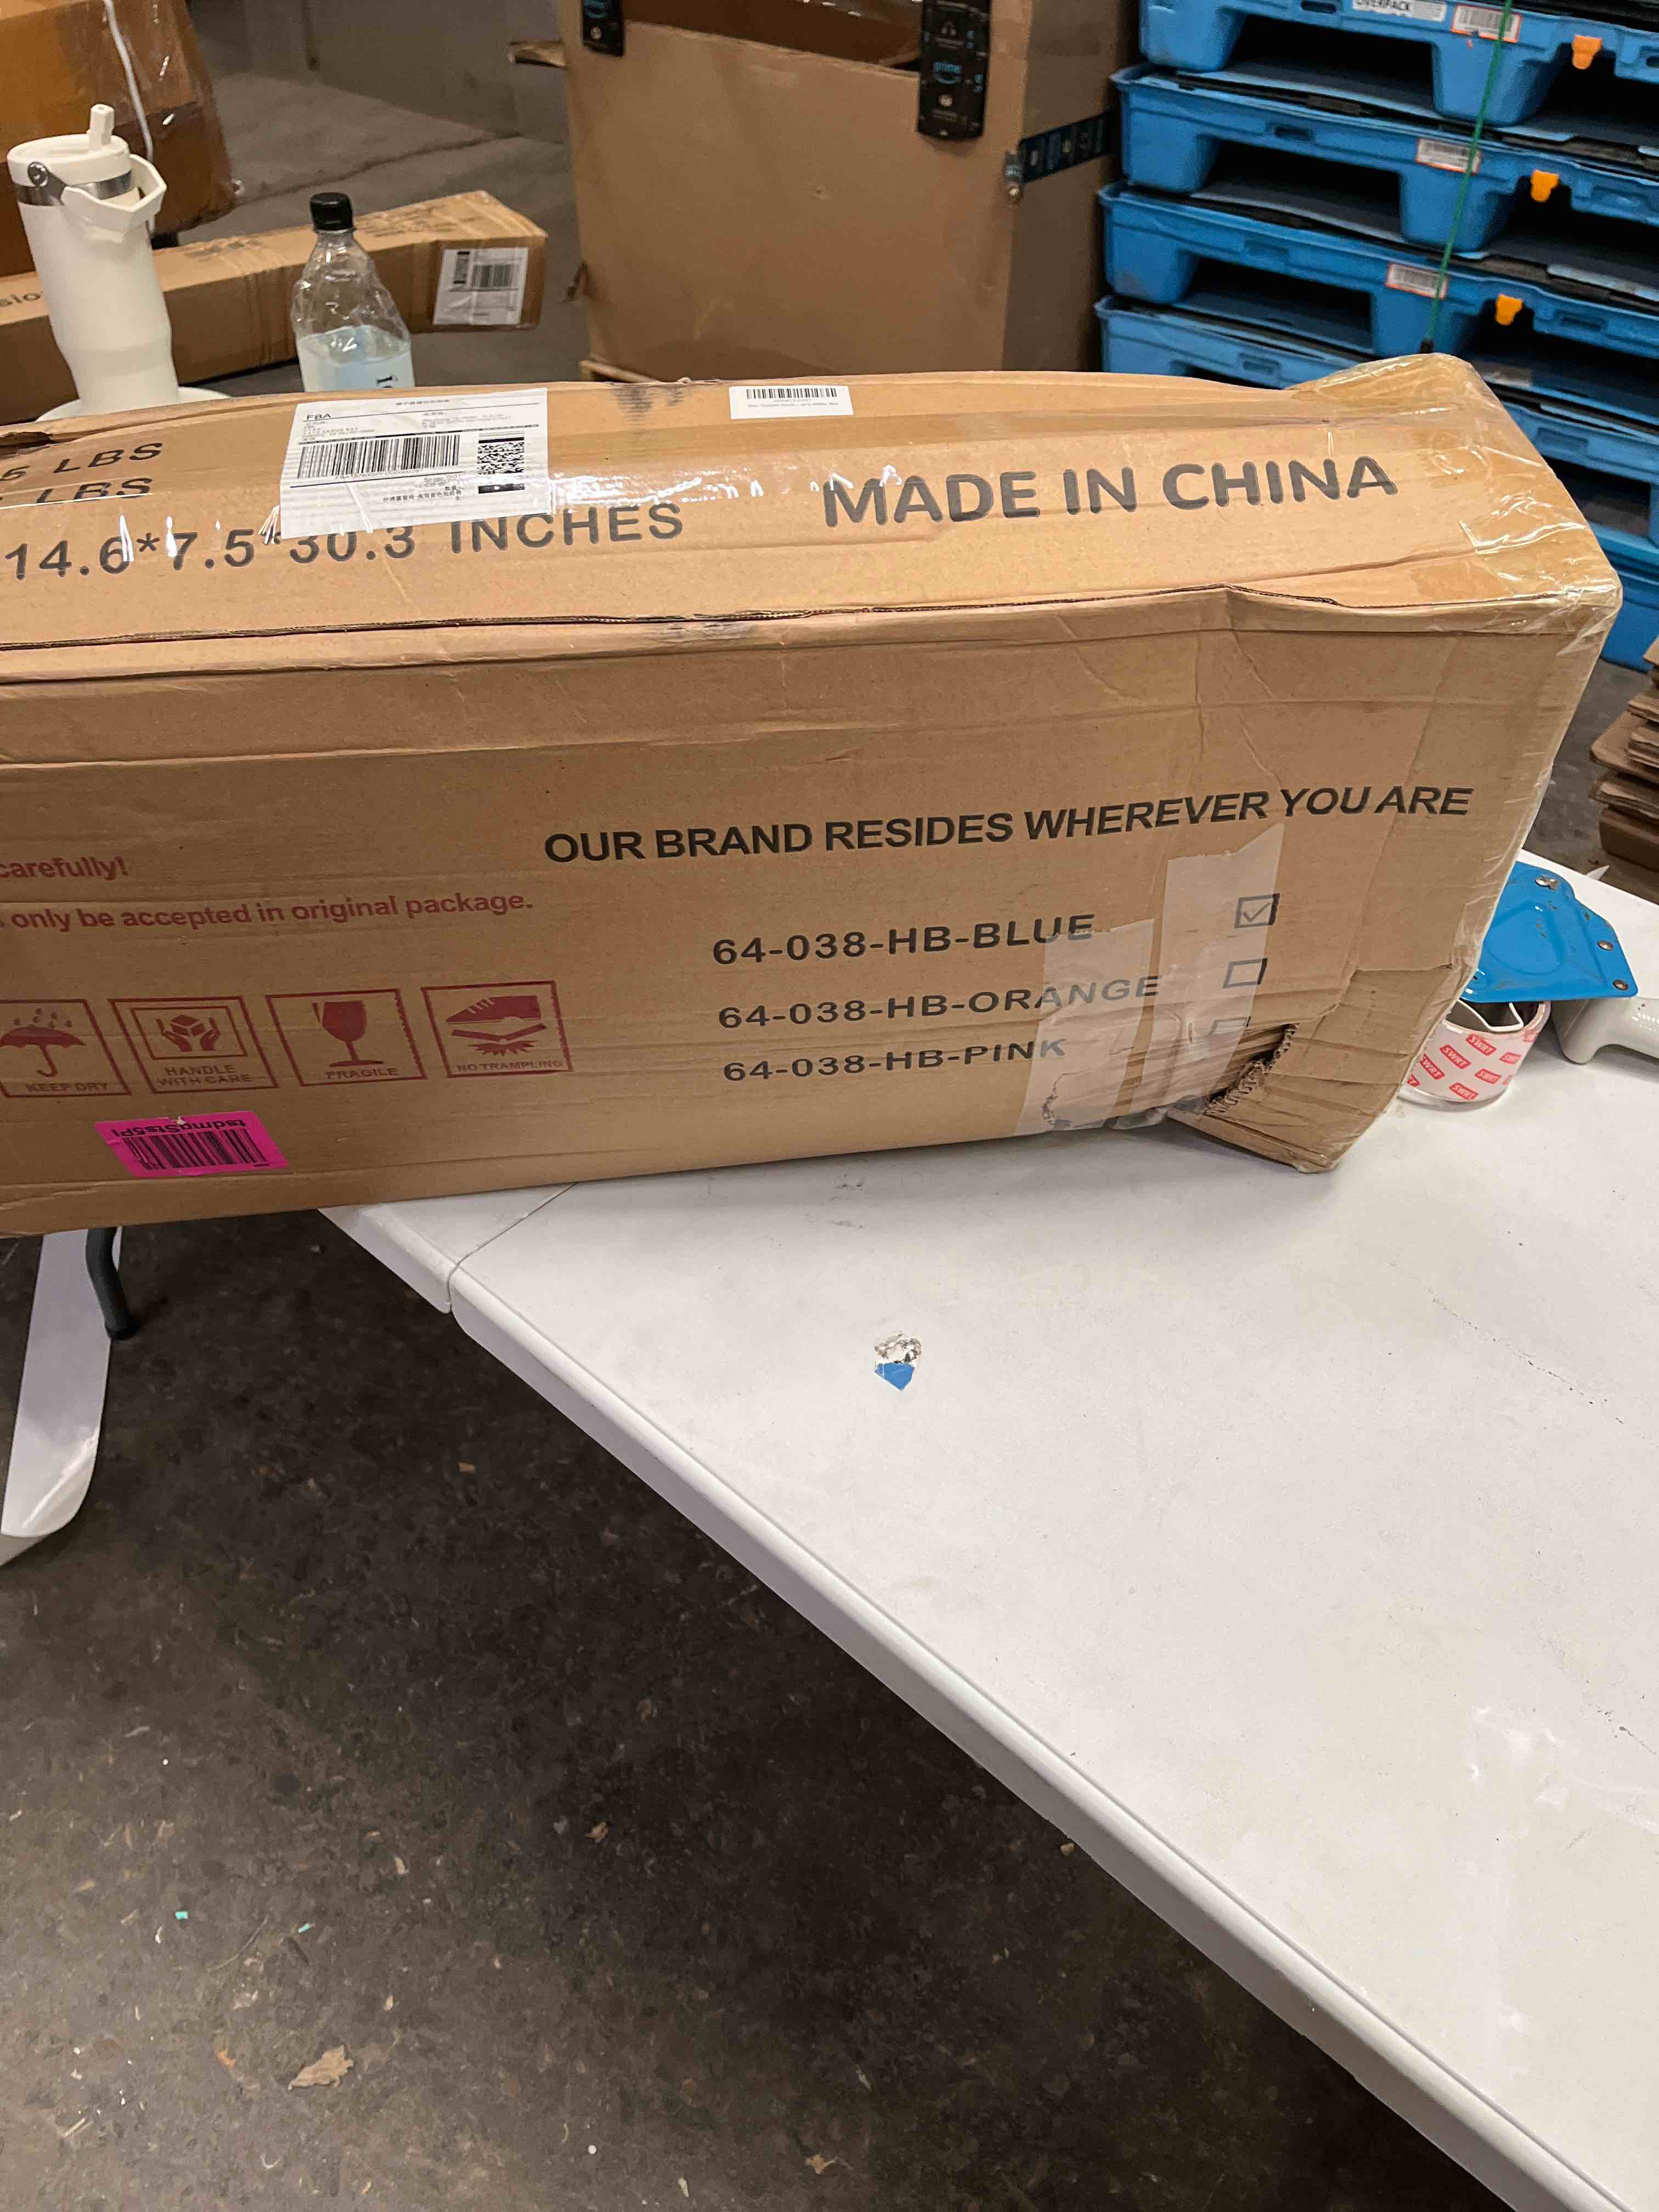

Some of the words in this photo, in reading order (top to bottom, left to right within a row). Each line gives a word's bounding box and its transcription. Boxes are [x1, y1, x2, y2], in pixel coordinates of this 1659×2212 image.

[53, 443, 162, 473] LBS
[823, 471, 1040, 528] MADE
[1063, 466, 1137, 515] IN
[1163, 456, 1398, 510] CHINA
[450, 503, 683, 554] INCHES
[545, 831, 646, 863] OUR
[654, 823, 812, 858] BRAND
[825, 812, 1013, 851] RESIDES
[1024, 791, 1269, 840] WHEREVER
[1279, 786, 1371, 817] YOU
[1374, 786, 1474, 817] ARE
[0, 856, 128, 880] carefully!
[12, 908, 71, 932] only
[80, 908, 114, 928] be
[122, 904, 252, 931] accepted
[258, 902, 285, 923] in
[291, 895, 399, 925] original
[405, 892, 533, 918] package.
[712, 913, 1096, 965] 64-038-HB-BLUE
[718, 975, 1160, 1029] 64-038-HB-ORANGE
[1444, 1046, 1468, 1068] SWRT
[1470, 1035, 1494, 1054] SWRT
[165, 1064, 236, 1077] HANDLE
[325, 1068, 400, 1079] FRAGILE
[456, 1063, 478, 1072] NO
[481, 1060, 563, 1071] TRAMPLING
[723, 1039, 1066, 1082] 64-038-HB-PINK
[25, 1082, 70, 1093] KEEP
[75, 1082, 109, 1091] DRY
[156, 1076, 201, 1087] WITH
[202, 1074, 252, 1084] CARE
